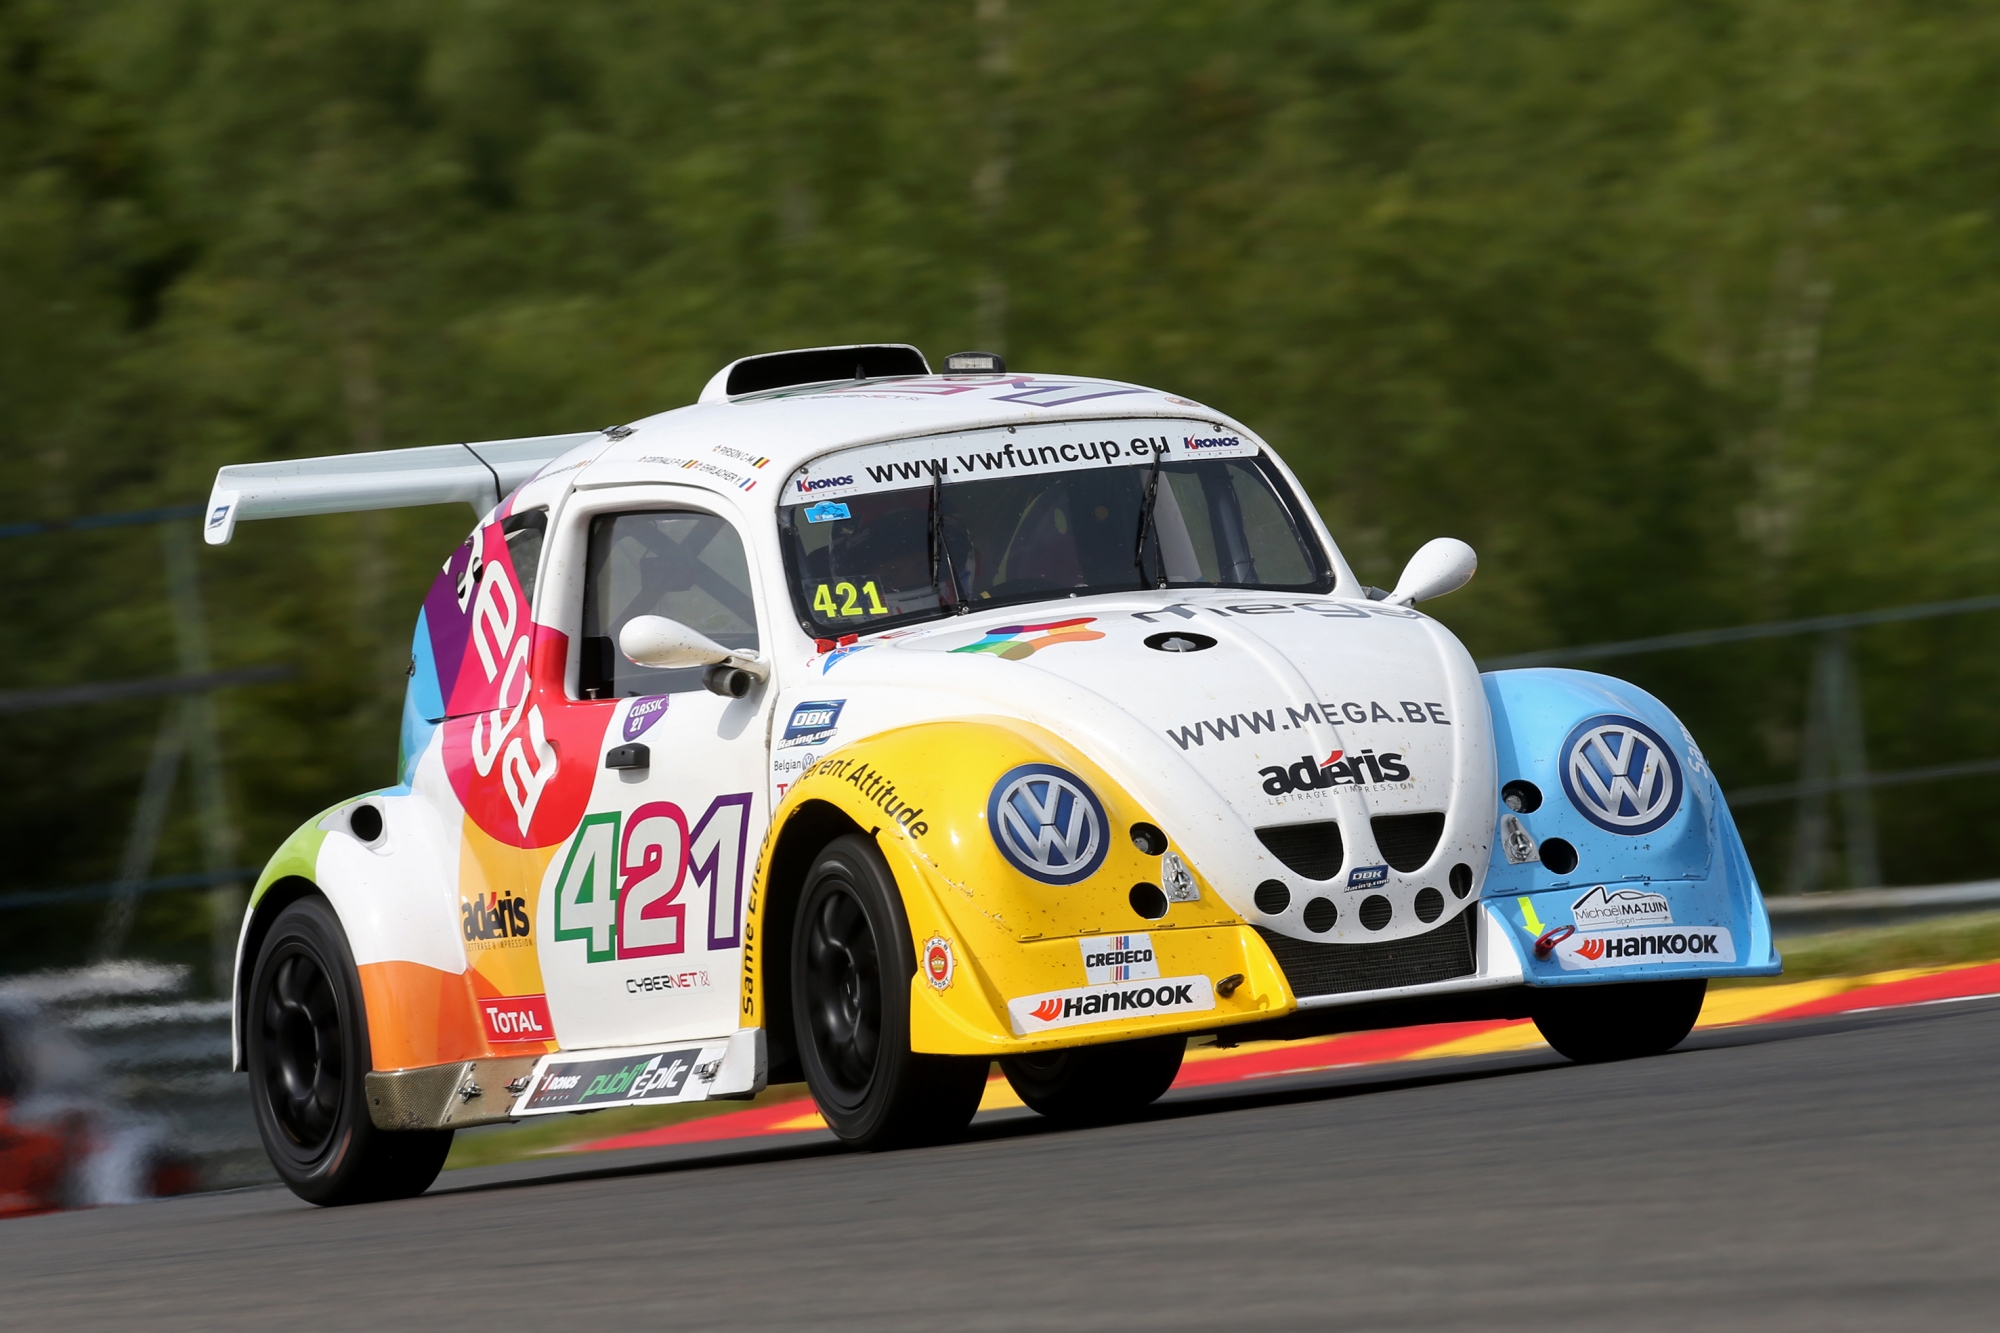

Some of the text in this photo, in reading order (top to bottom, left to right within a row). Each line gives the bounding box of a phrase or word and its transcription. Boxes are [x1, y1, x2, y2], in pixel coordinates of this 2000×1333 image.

[1183, 433, 1240, 450] KRONOS
[865, 435, 1171, 484] www.vwfuncup.eu
[796, 475, 854, 493] KRONOS
[813, 581, 888, 618] 421
[629, 697, 666, 718] CLASSIC
[629, 715, 645, 733] 21
[1166, 701, 1451, 750] WWW.MEGA.BE
[777, 727, 838, 751] Racing.com
[774, 760, 802, 773] Belgian
[1257, 748, 1411, 796] adéris
[1268, 790, 1328, 805] LETTRAGE
[1344, 783, 1415, 793] IMPRESSION
[554, 791, 754, 964] 421
[743, 922, 754, 1016] Same
[845, 763, 929, 840] Attitude
[461, 891, 531, 943] adéris
[1575, 902, 1669, 921] Michaël MAZUIN
[1615, 916, 1636, 926] Sport
[1086, 949, 1153, 968] CREDECO
